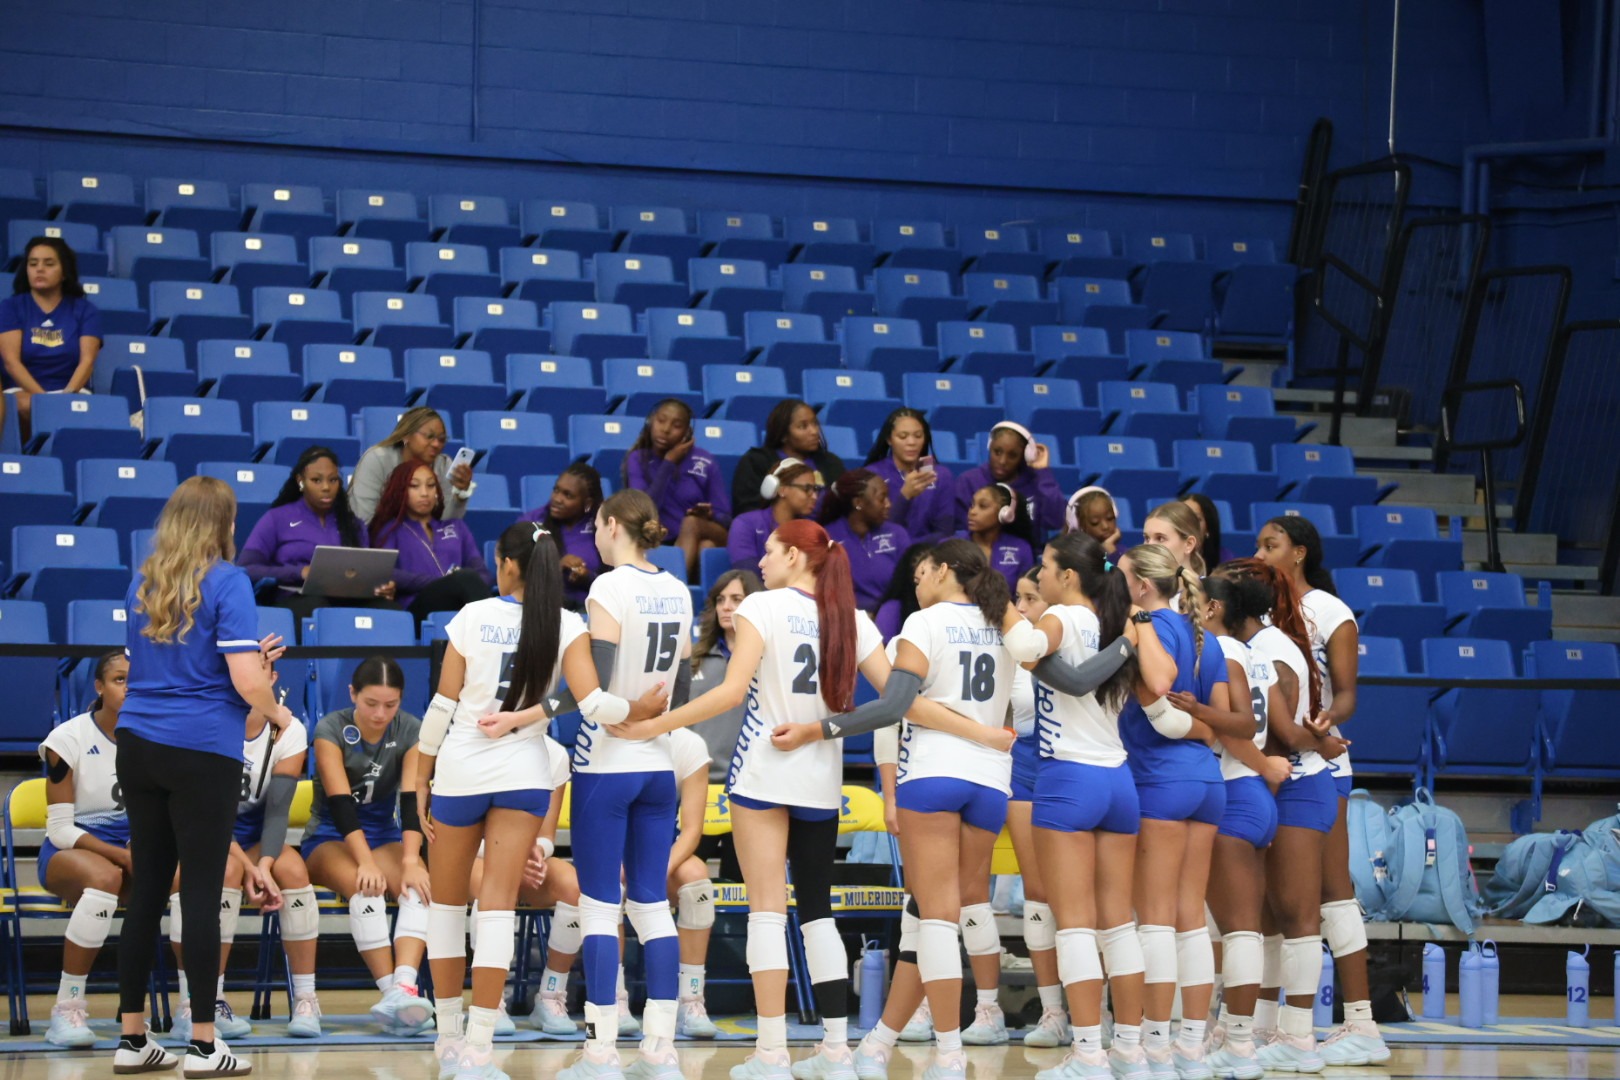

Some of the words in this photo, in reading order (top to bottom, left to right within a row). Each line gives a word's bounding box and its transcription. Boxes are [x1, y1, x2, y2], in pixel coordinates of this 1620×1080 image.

[480, 624, 522, 646] TAM
[787, 615, 821, 639] TAM
[643, 621, 681, 673] 15
[792, 642, 818, 695] 2
[959, 650, 996, 702] 18
[362, 780, 375, 804] 1
[844, 890, 905, 906] MULERIDER
[1320, 985, 1333, 1006] 8
[1567, 985, 1586, 1003] 12
